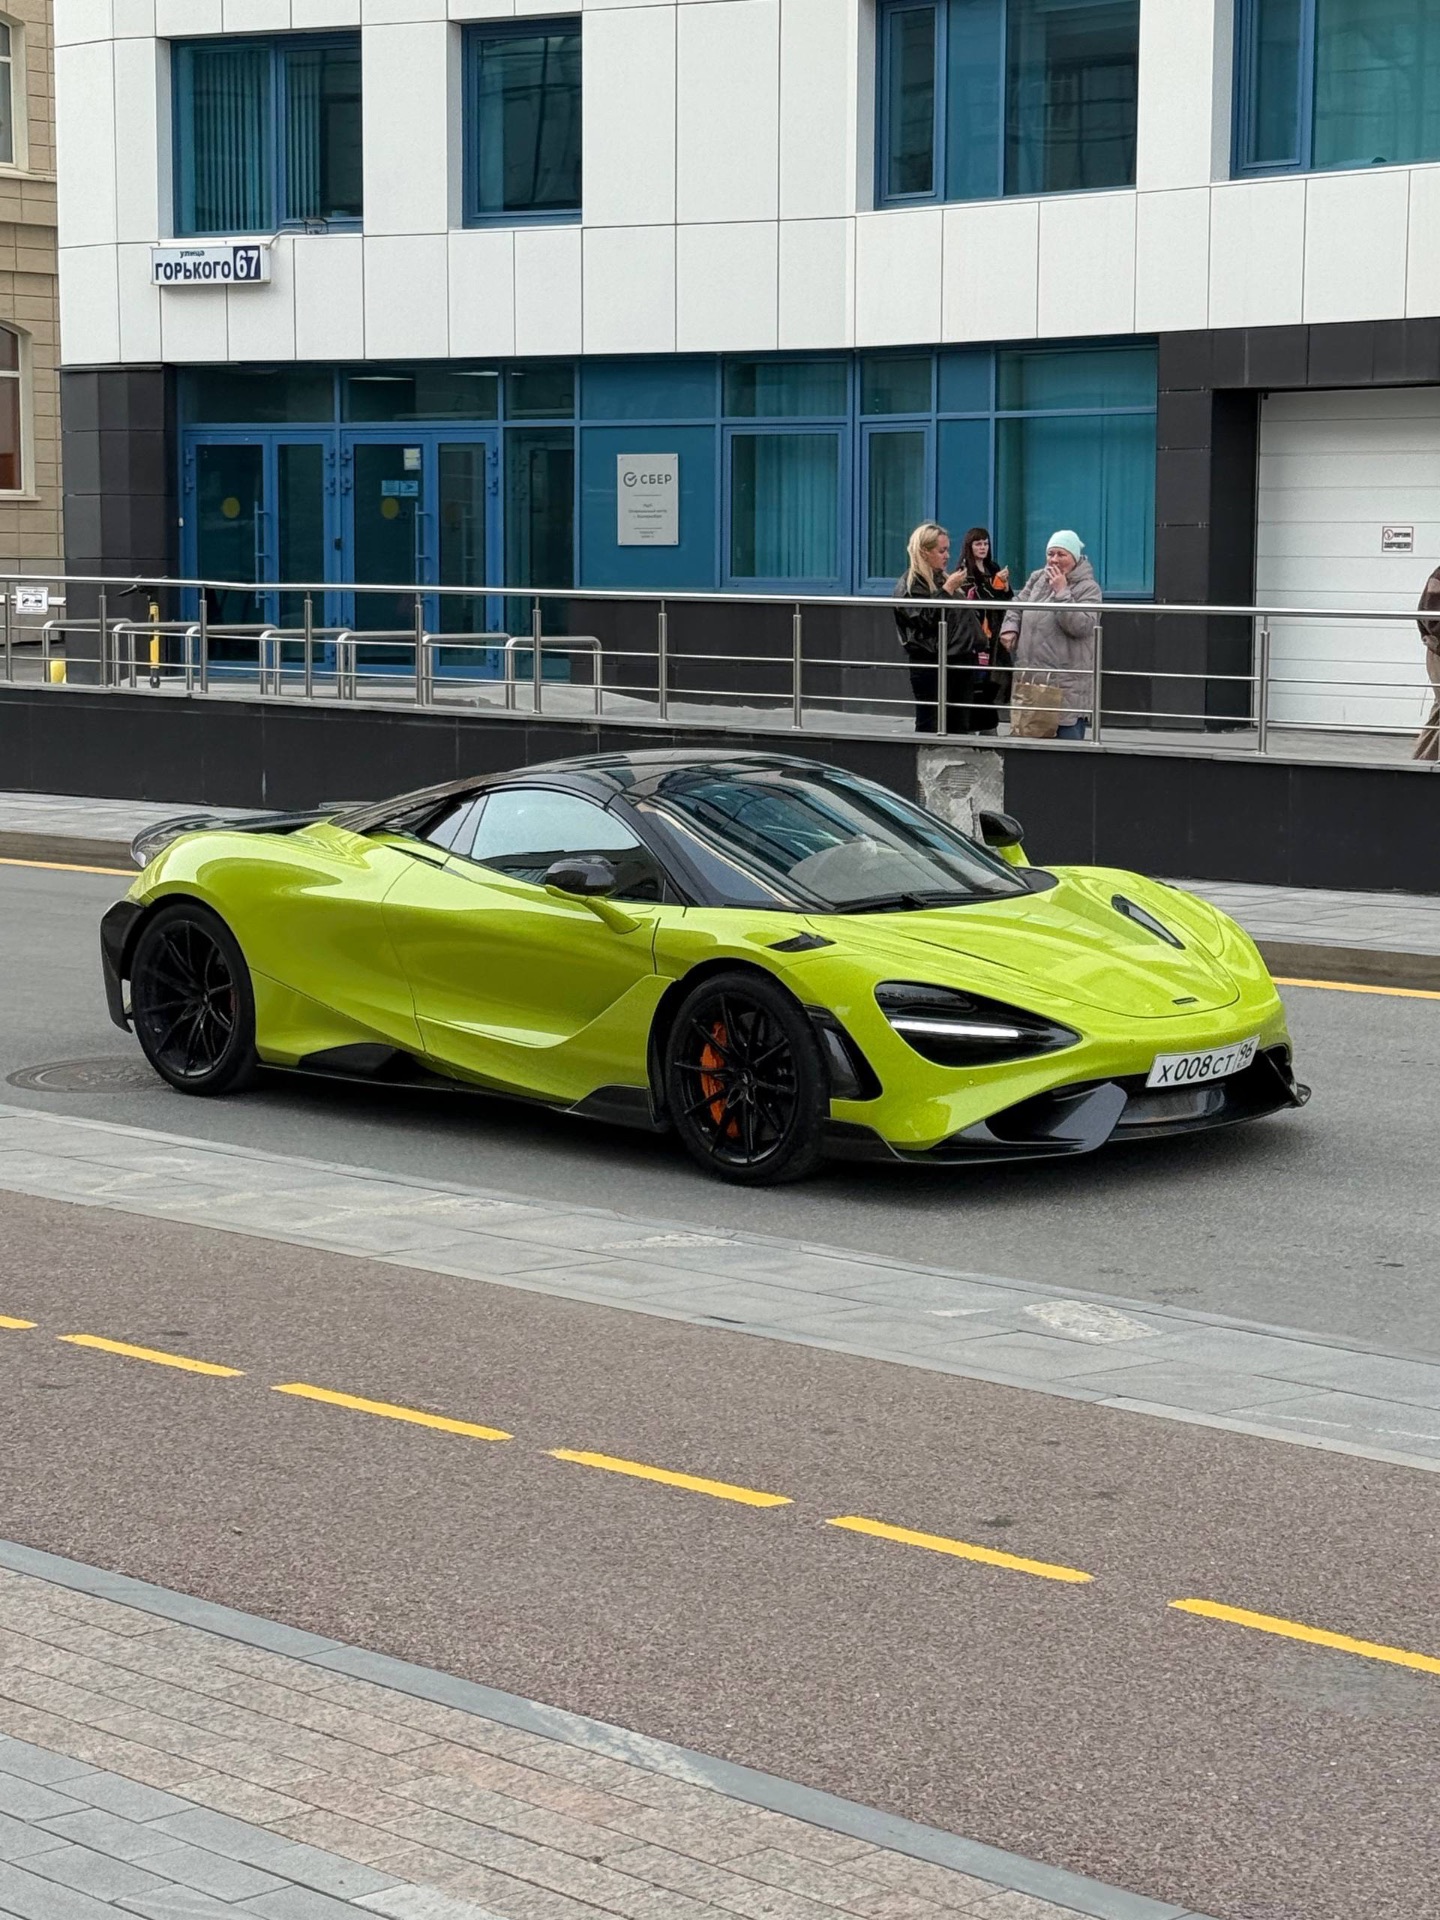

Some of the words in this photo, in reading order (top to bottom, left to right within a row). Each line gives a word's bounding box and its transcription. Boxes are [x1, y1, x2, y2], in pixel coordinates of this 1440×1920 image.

[180, 250, 205, 258] улица
[155, 261, 231, 280] ГОРЬКОГО
[235, 249, 259, 278] 67
[640, 474, 672, 485] СБЕР
